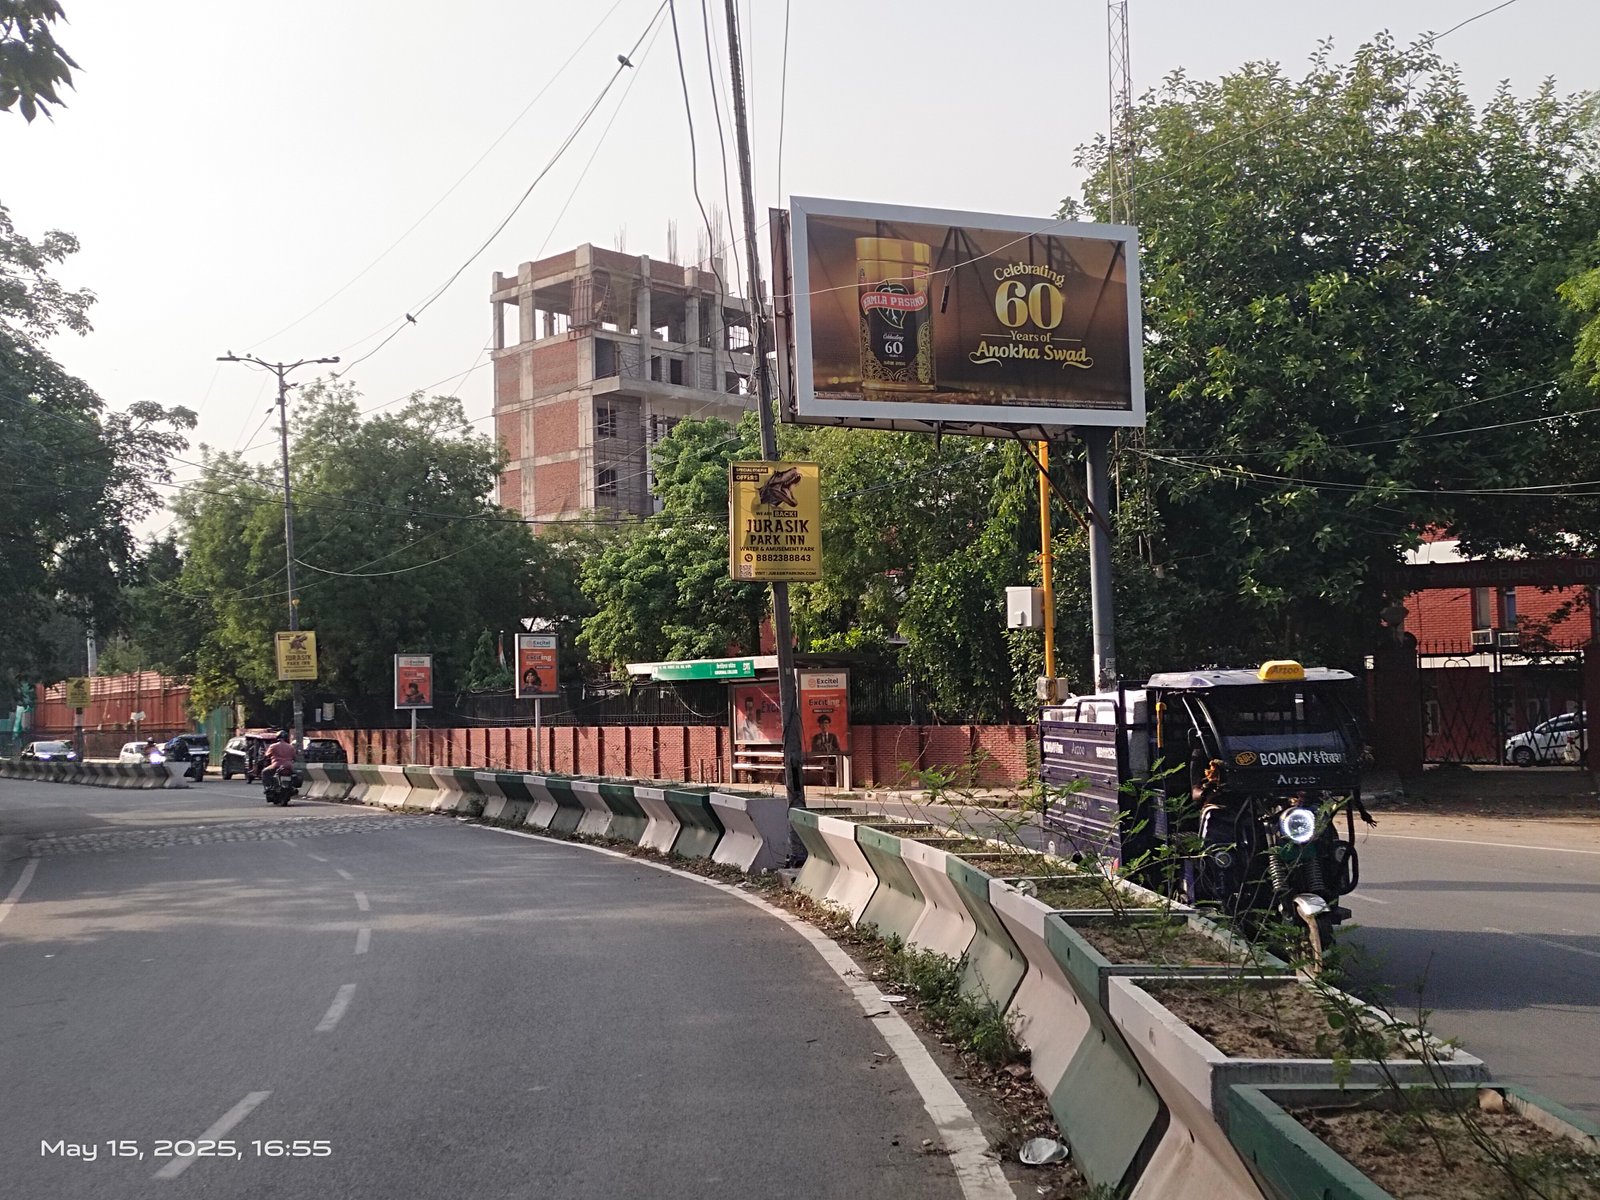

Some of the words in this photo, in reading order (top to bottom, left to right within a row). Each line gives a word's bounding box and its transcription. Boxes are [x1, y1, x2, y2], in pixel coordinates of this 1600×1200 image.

[993, 261, 1065, 288] Celebrating
[995, 280, 1063, 329] 60
[1010, 330, 1039, 342] Years
[1040, 332, 1052, 342] of
[885, 341, 903, 354] 60
[972, 341, 1041, 361] Anokha
[1043, 344, 1089, 363] Swad
[746, 519, 809, 533] JURASIK
[750, 535, 780, 545] PARK
[785, 535, 805, 545] INN
[756, 554, 811, 562] 8882388843
[816, 677, 839, 685] Excitel
[1260, 751, 1312, 766] BOMBAY
